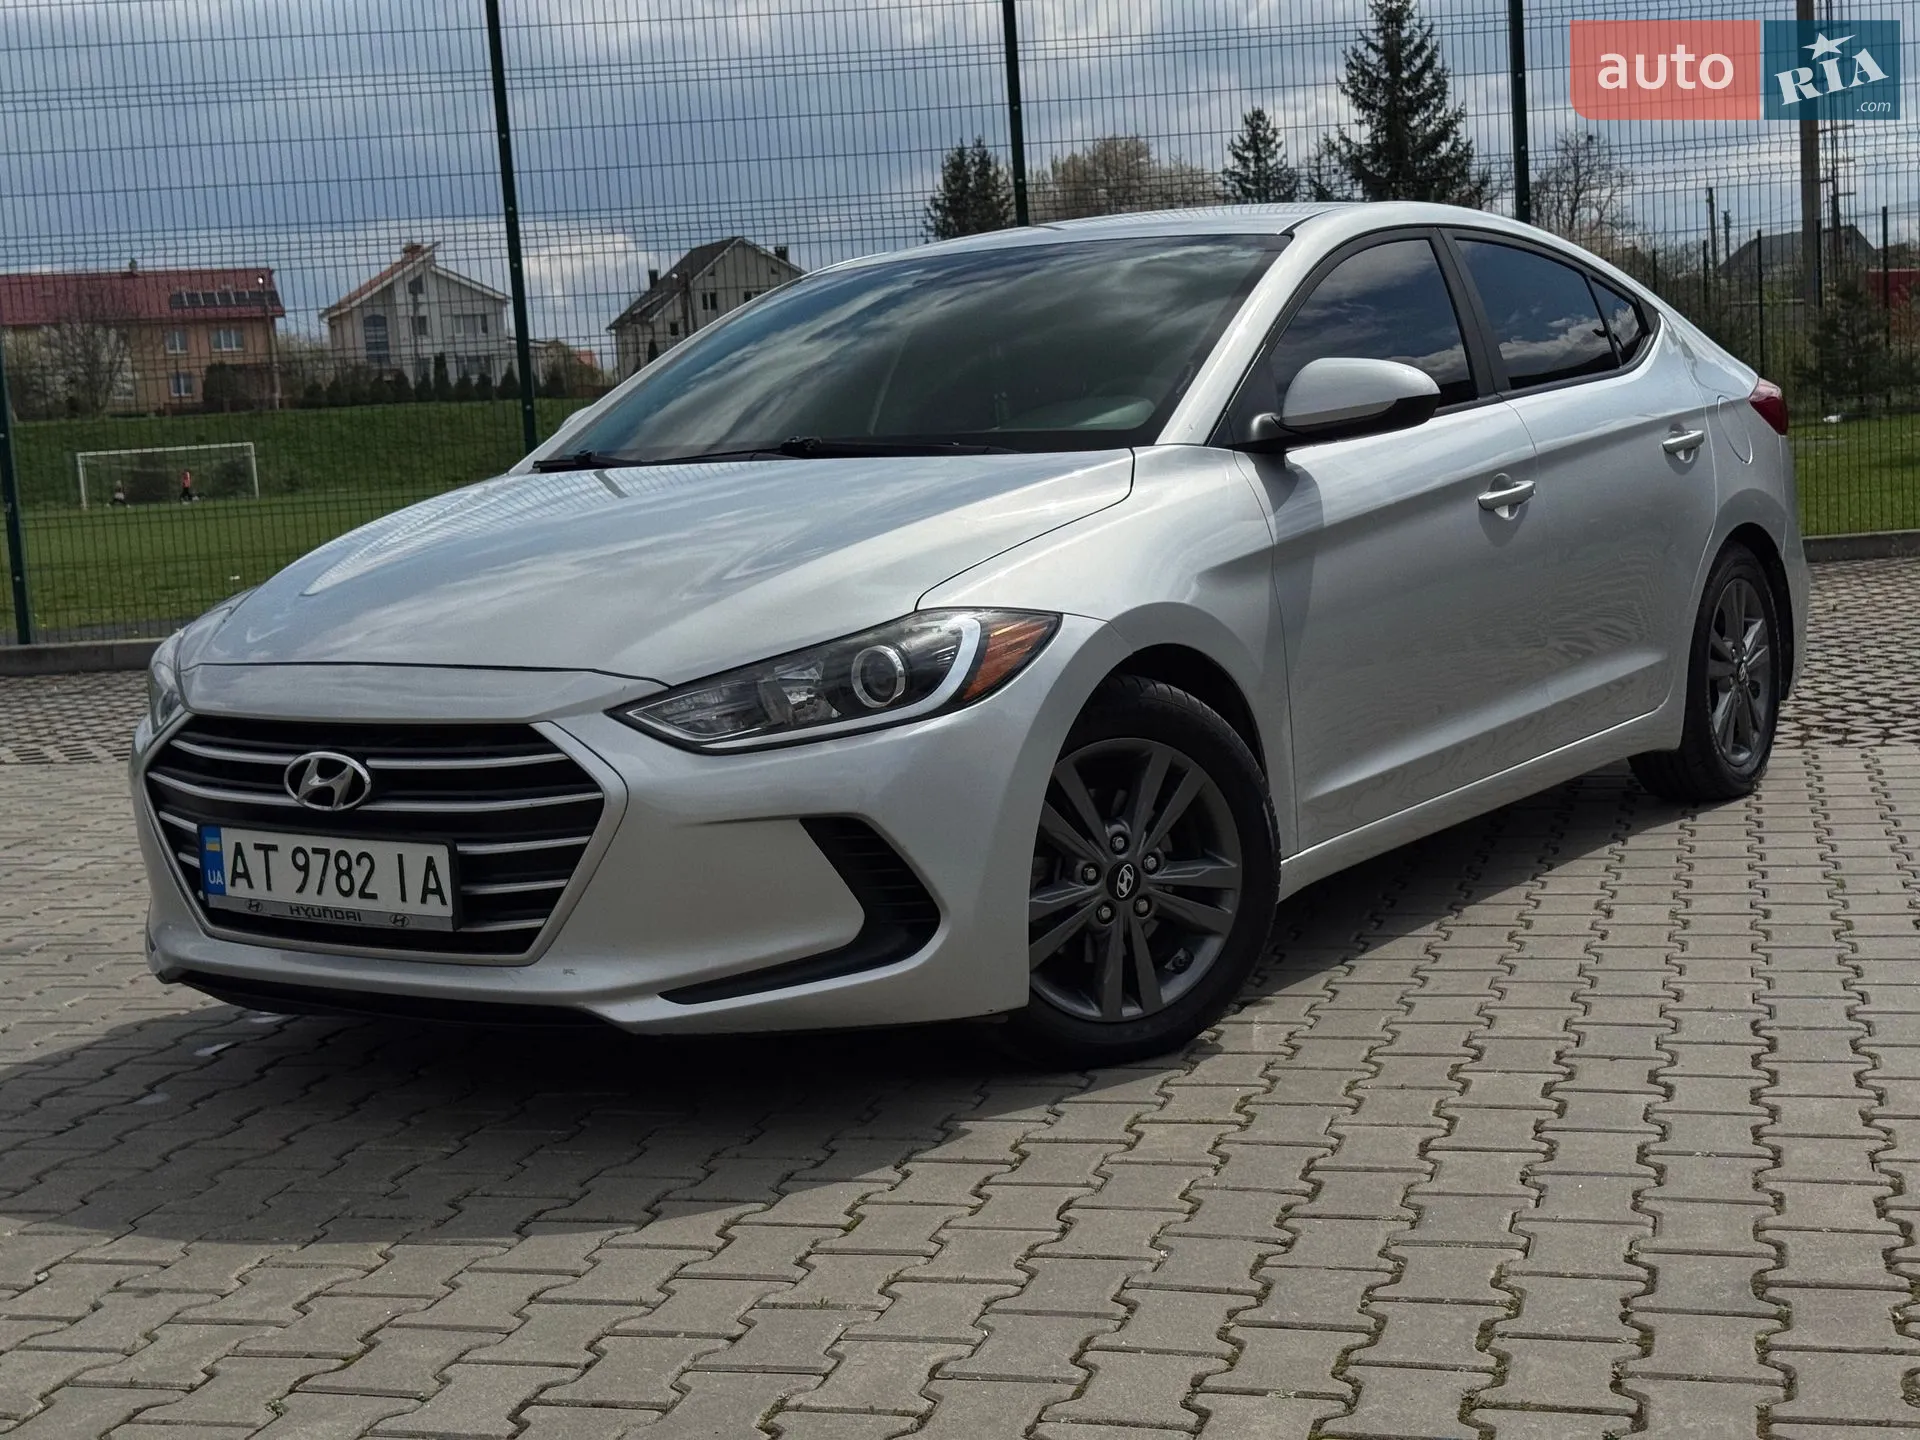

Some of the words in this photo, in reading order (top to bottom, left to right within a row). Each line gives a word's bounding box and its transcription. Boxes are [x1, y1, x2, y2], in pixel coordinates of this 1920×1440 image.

[207, 868, 224, 887] UA
[230, 842, 278, 892] AT
[291, 846, 378, 900] 9782
[397, 853, 448, 906] IA
